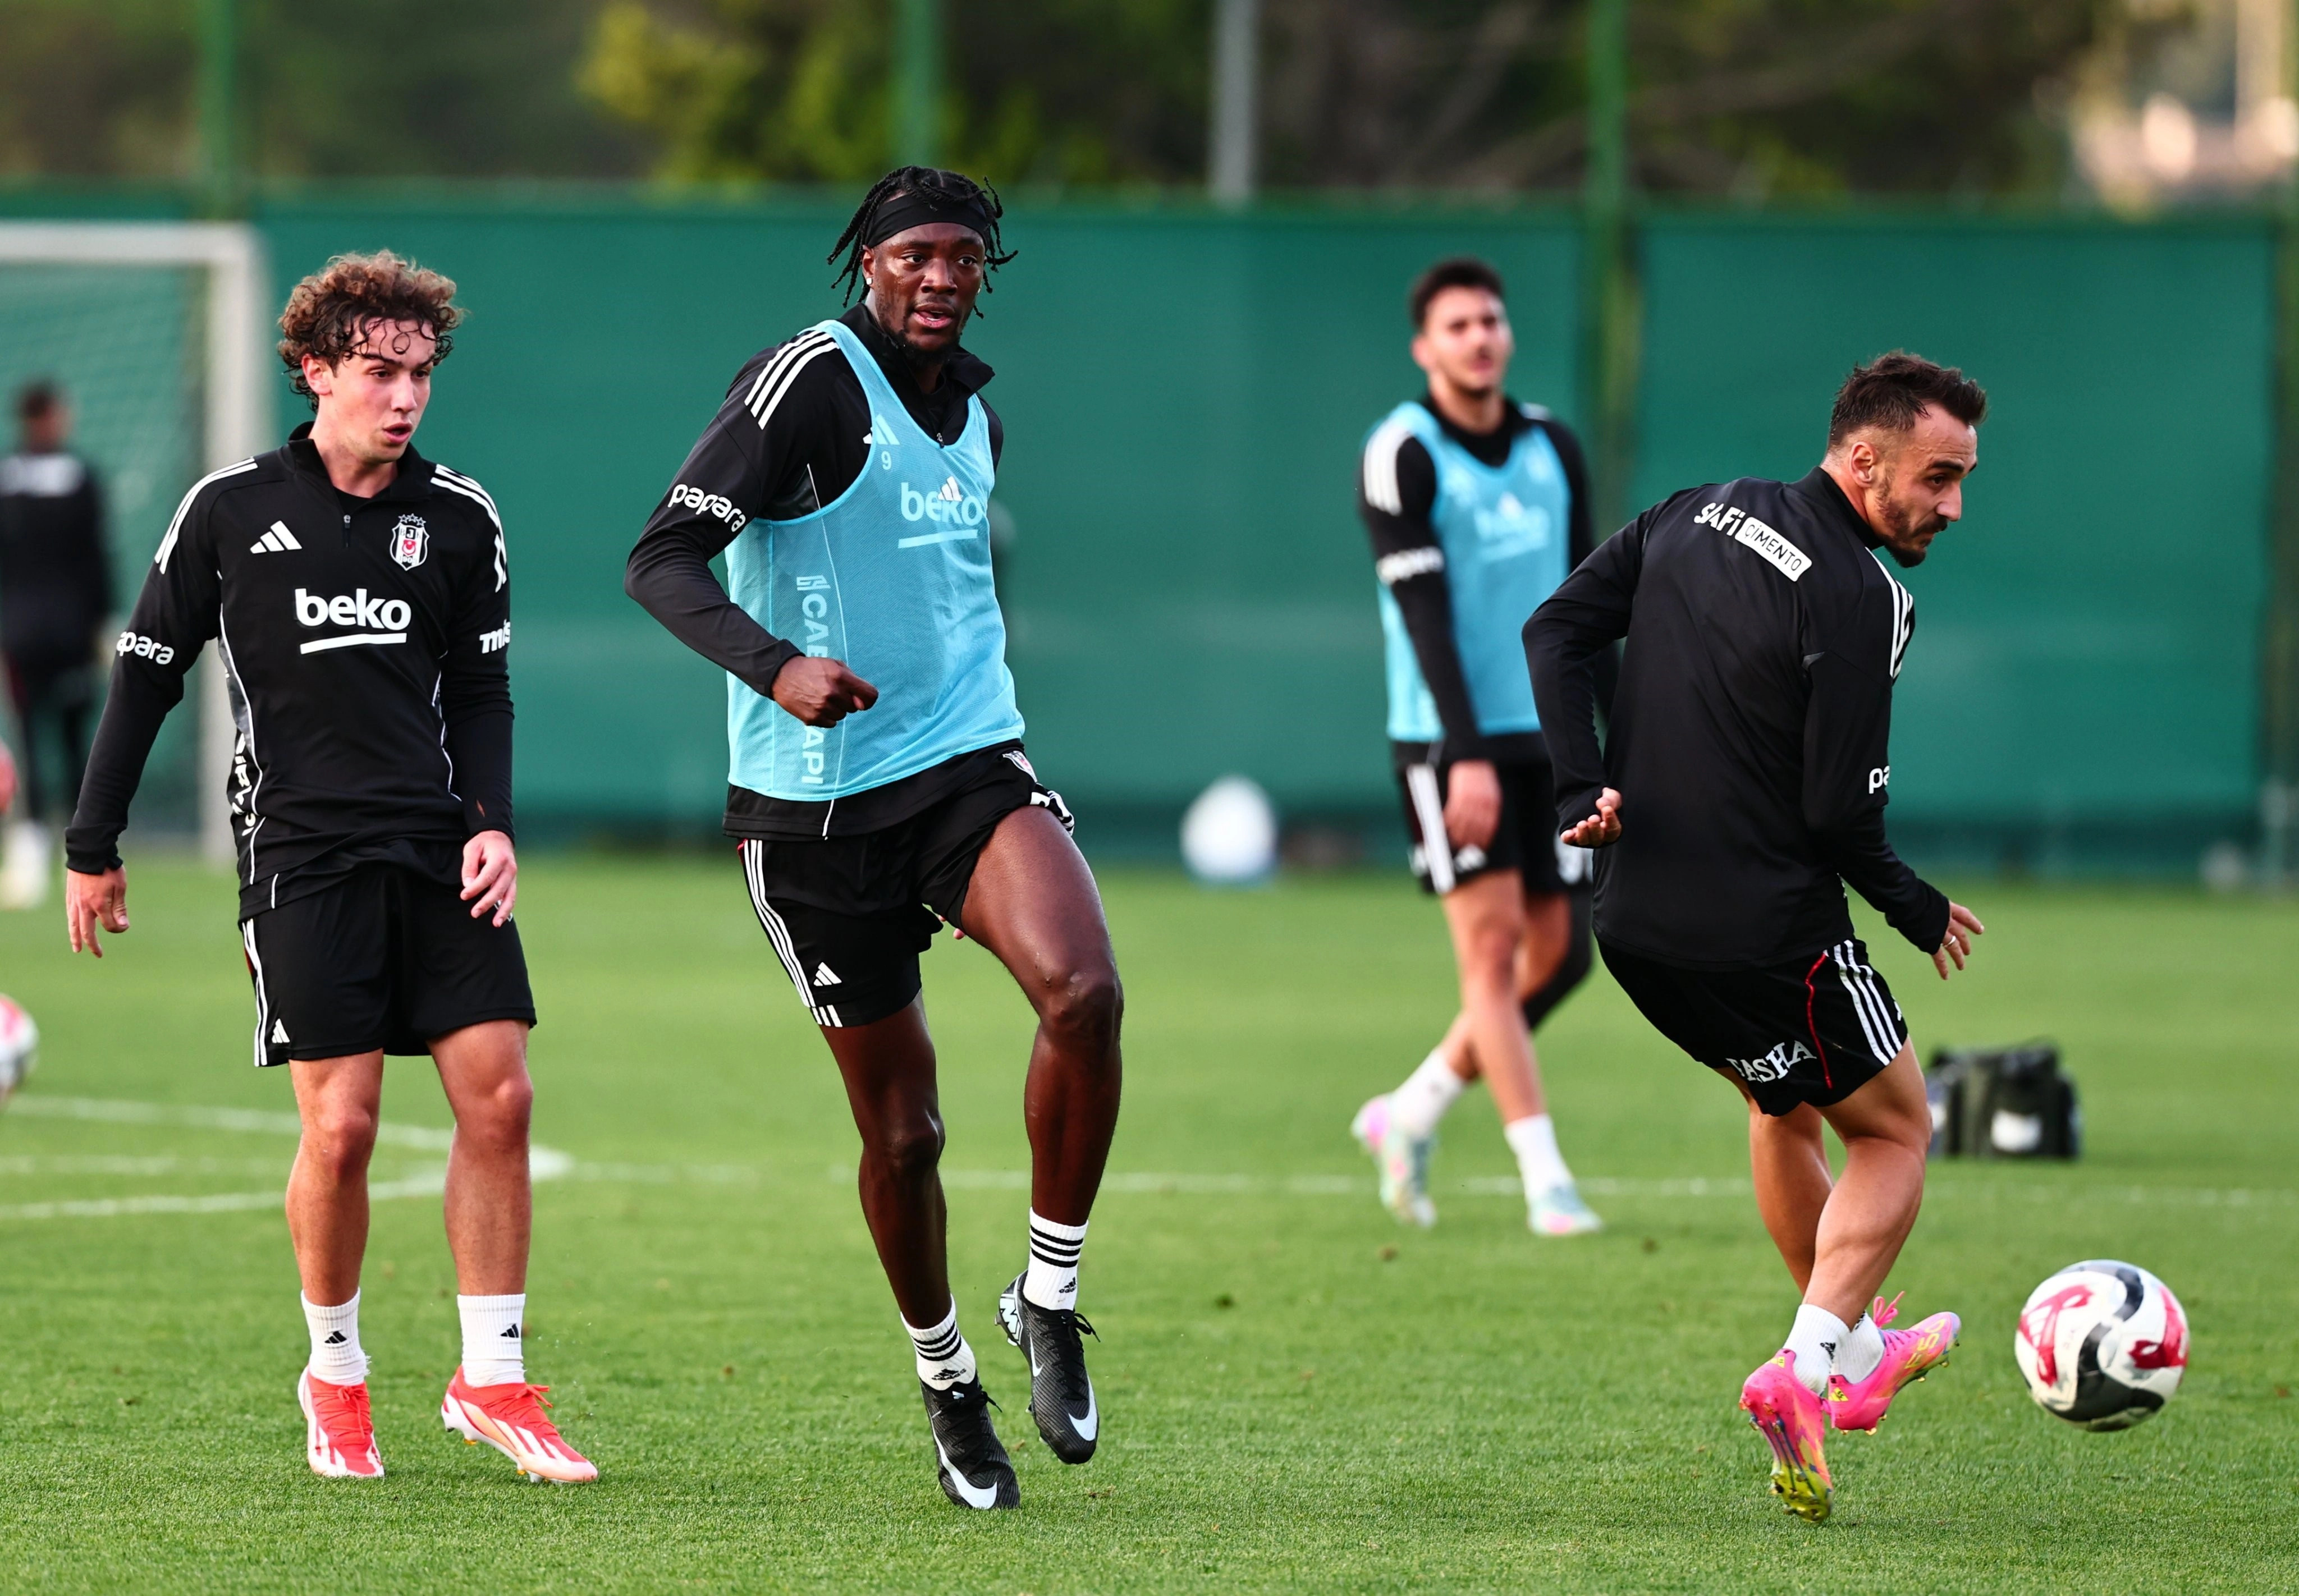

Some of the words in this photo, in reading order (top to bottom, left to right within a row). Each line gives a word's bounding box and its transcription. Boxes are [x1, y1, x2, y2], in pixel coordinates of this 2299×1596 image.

[881, 451, 892, 470] 9
[667, 484, 746, 532] papara
[901, 482, 983, 526] beko
[295, 588, 411, 631] beko
